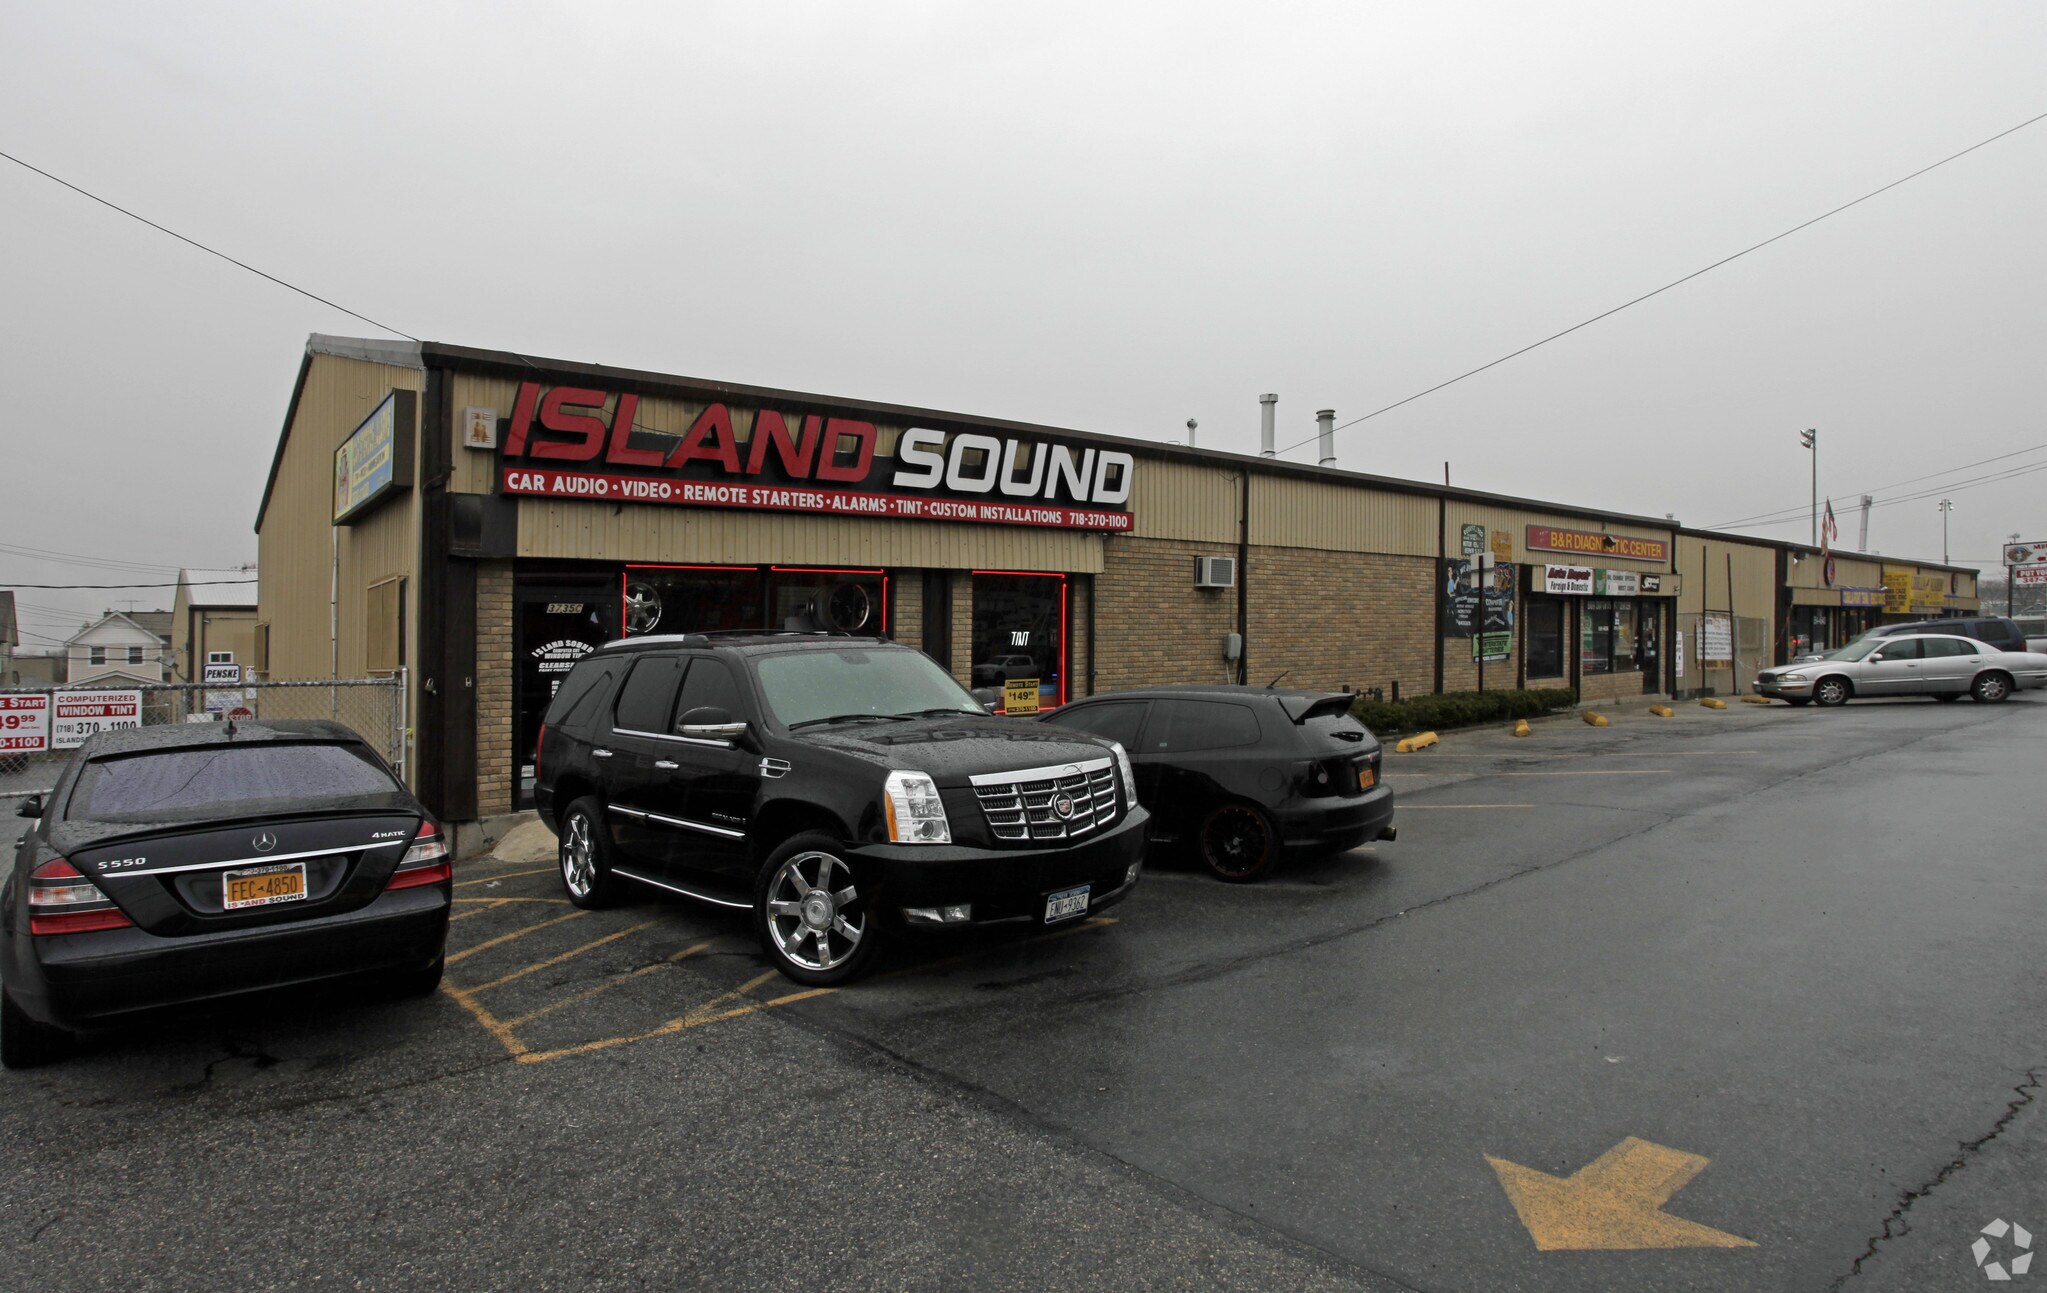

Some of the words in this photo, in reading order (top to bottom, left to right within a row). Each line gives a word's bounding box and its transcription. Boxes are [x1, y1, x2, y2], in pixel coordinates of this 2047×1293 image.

[504, 381, 877, 482] ISLAND
[893, 427, 1134, 504] SOUND
[508, 472, 545, 491] CAR
[552, 476, 608, 494] AUDIO
[621, 480, 671, 498] VIDEO
[684, 485, 747, 503] REMOTE
[752, 489, 823, 508] STARTERS
[831, 495, 887, 512] ALARMS
[896, 500, 922, 514] TINT
[930, 501, 977, 518] CUSTOM
[980, 506, 1062, 524] INSTALLATIONS
[1069, 512, 1128, 528] 718-370-1100
[1550, 531, 1573, 548] B&R
[1629, 541, 1662, 557] CENTER
[1550, 581, 1566, 593] Foreign
[1571, 582, 1588, 592] Domestic
[531, 640, 564, 658] ISLAND
[565, 639, 595, 654] SOUND
[206, 669, 238, 679] PENSKE
[10, 698, 46, 708] START
[58, 694, 136, 703] COMPUTERIZED
[60, 705, 105, 716] WINDOW
[110, 705, 134, 715] TINT
[56, 724, 75, 733] (718)
[227, 898, 266, 908] ISAND
[269, 893, 304, 904] SOUND
